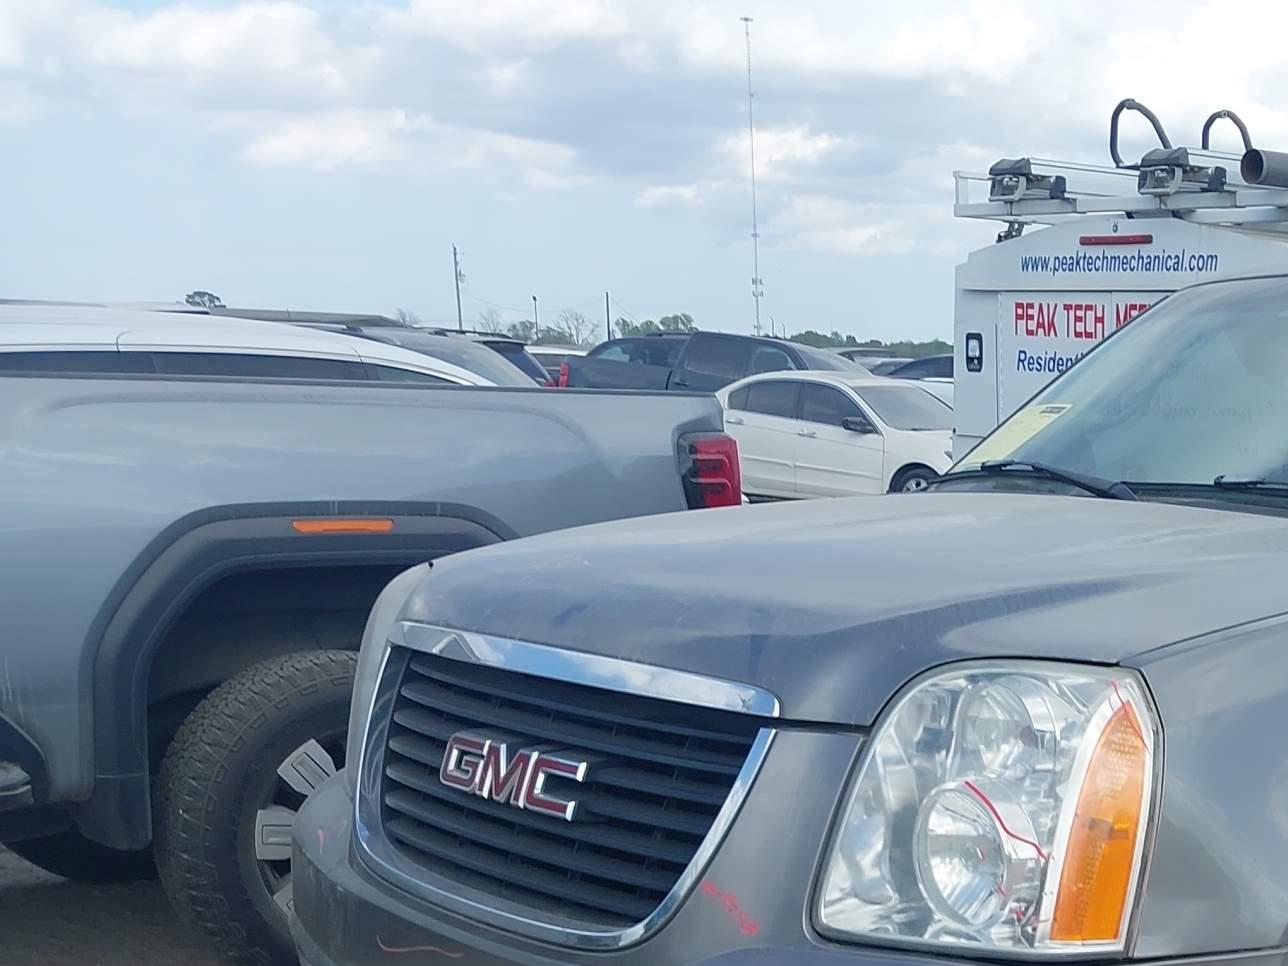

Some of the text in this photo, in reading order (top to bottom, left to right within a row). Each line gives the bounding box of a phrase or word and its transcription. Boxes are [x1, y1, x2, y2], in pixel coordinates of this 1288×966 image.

[1020, 249, 1219, 277] www.peaktechmechanical.com
[1014, 301, 1058, 337] PEAK
[1062, 303, 1106, 340] TECH
[440, 734, 588, 822] GMC
